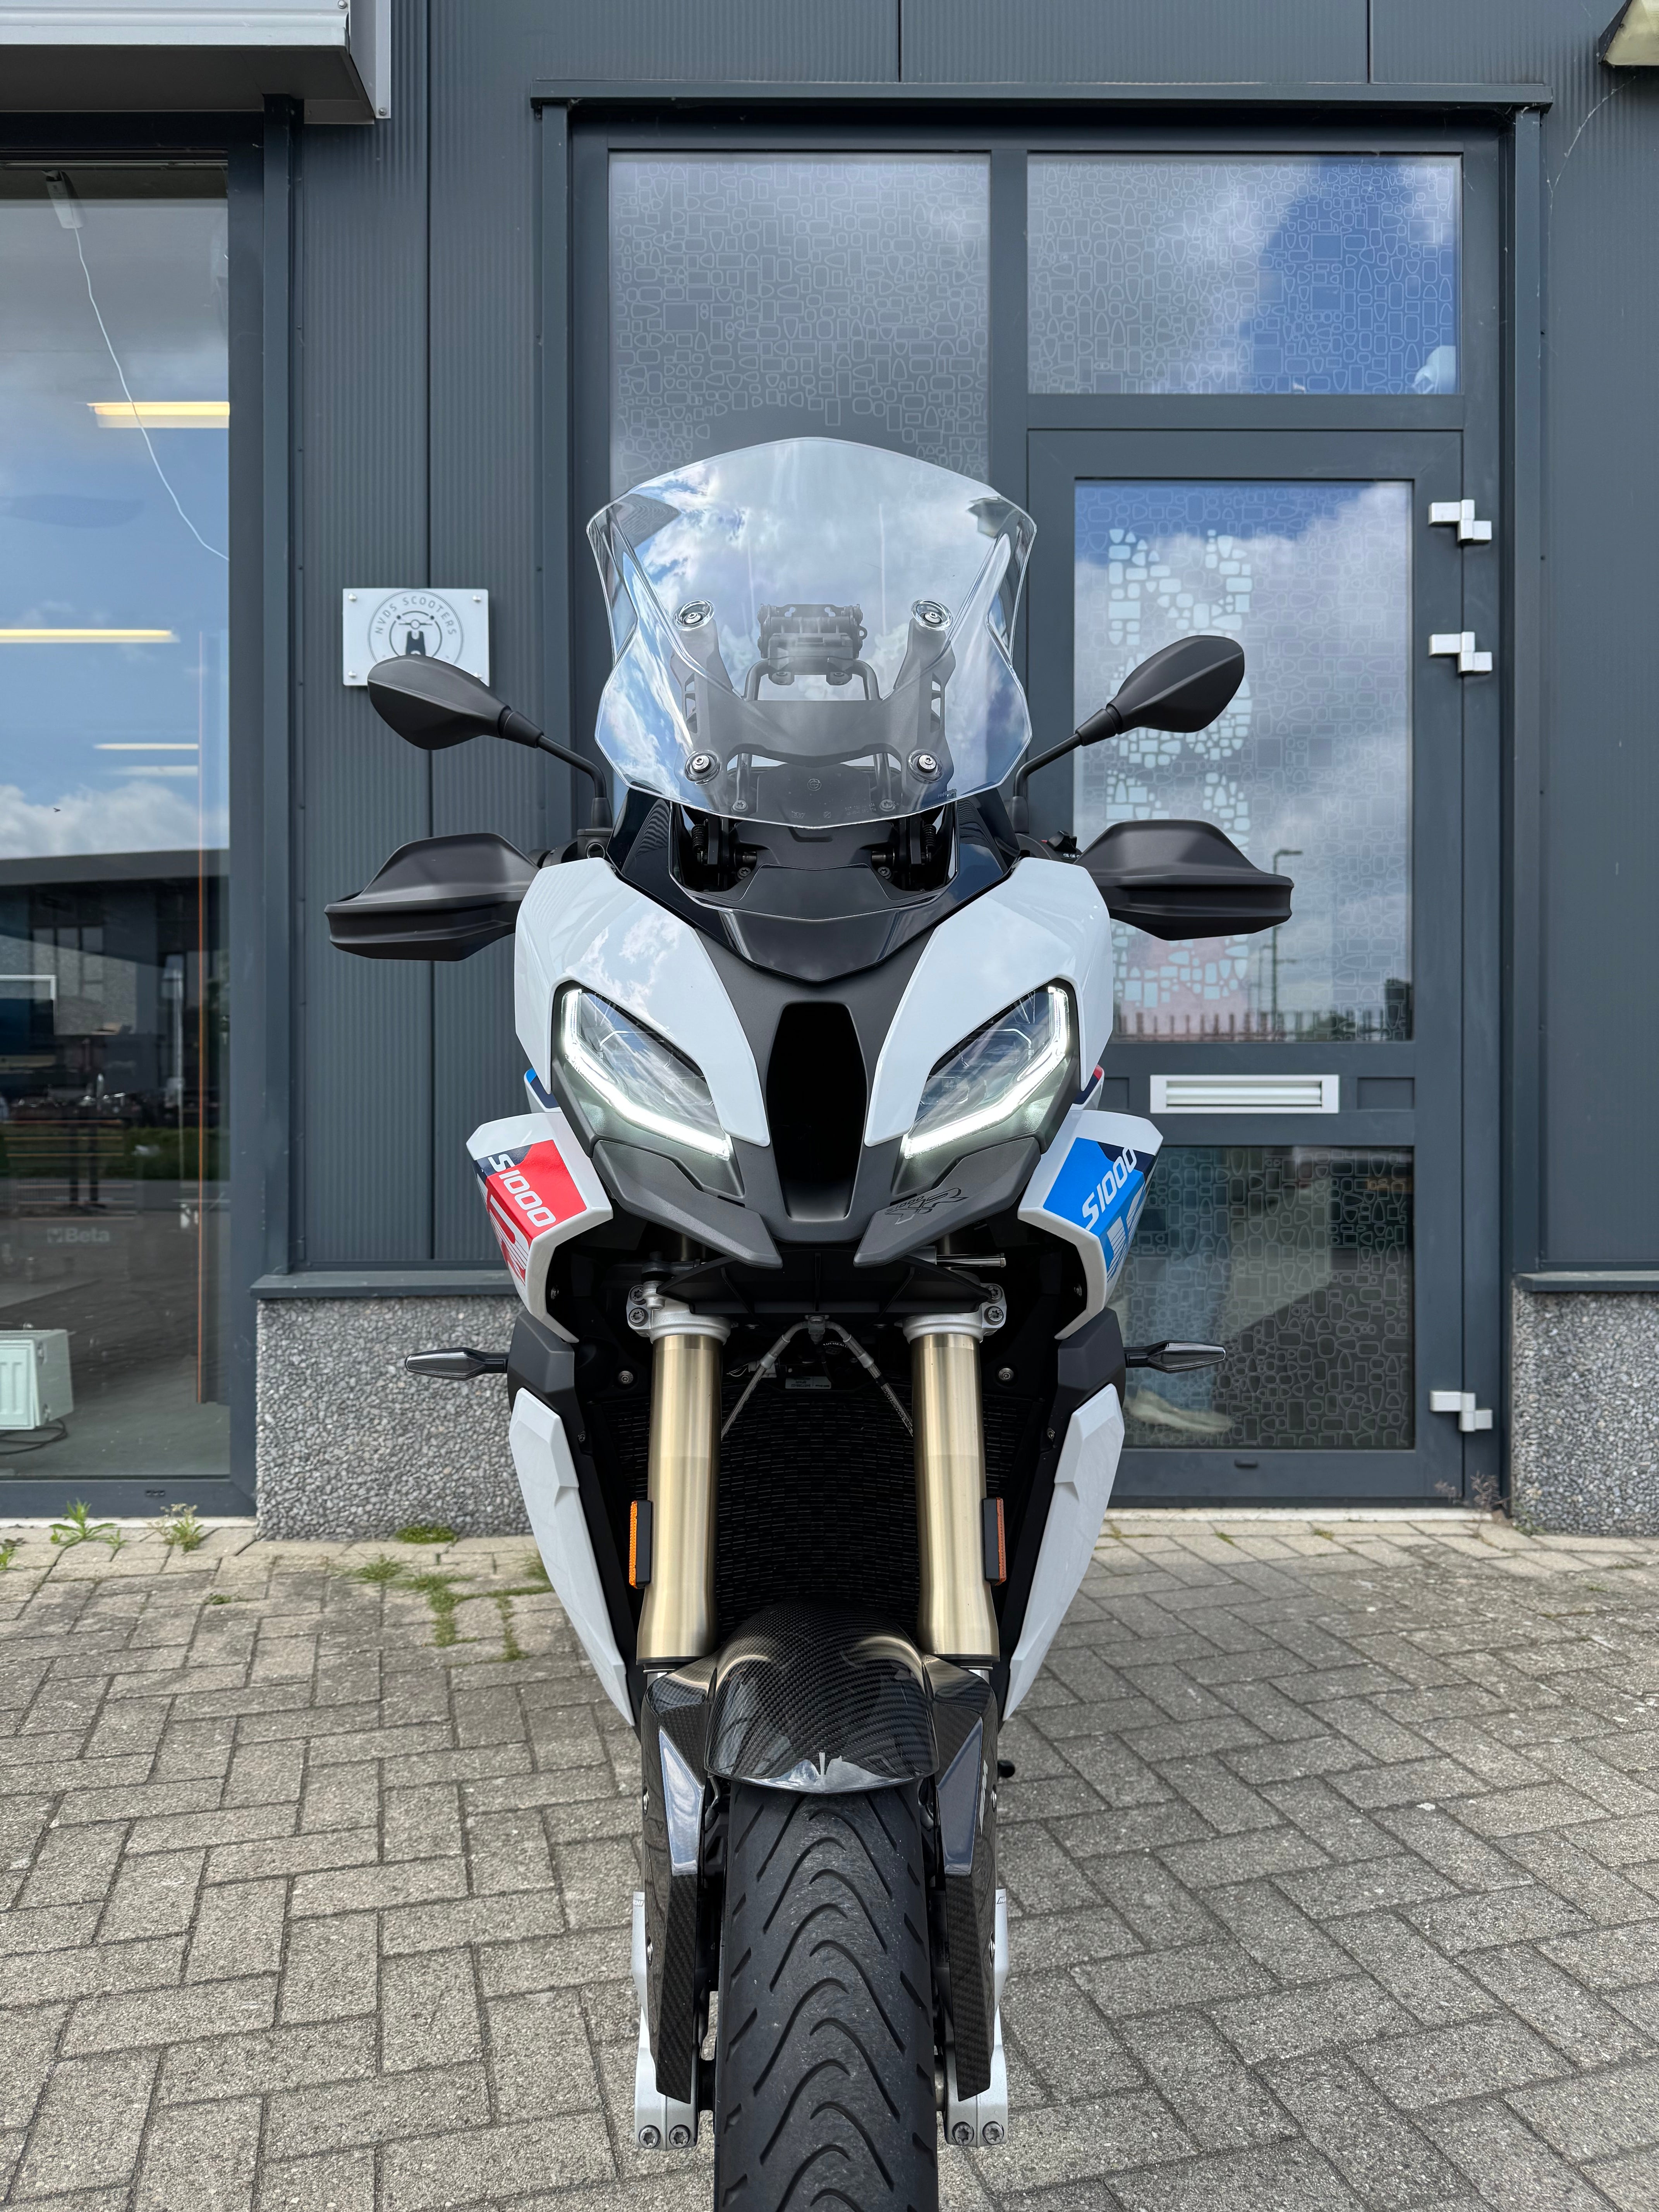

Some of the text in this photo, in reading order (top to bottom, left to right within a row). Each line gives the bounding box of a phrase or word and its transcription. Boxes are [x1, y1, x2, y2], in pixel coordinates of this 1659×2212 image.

[374, 596, 457, 635] NVDS SCOOTERS
[488, 1154, 556, 1227] S1000
[1082, 1147, 1137, 1231] S1000
[65, 1227, 110, 1243] Beta
